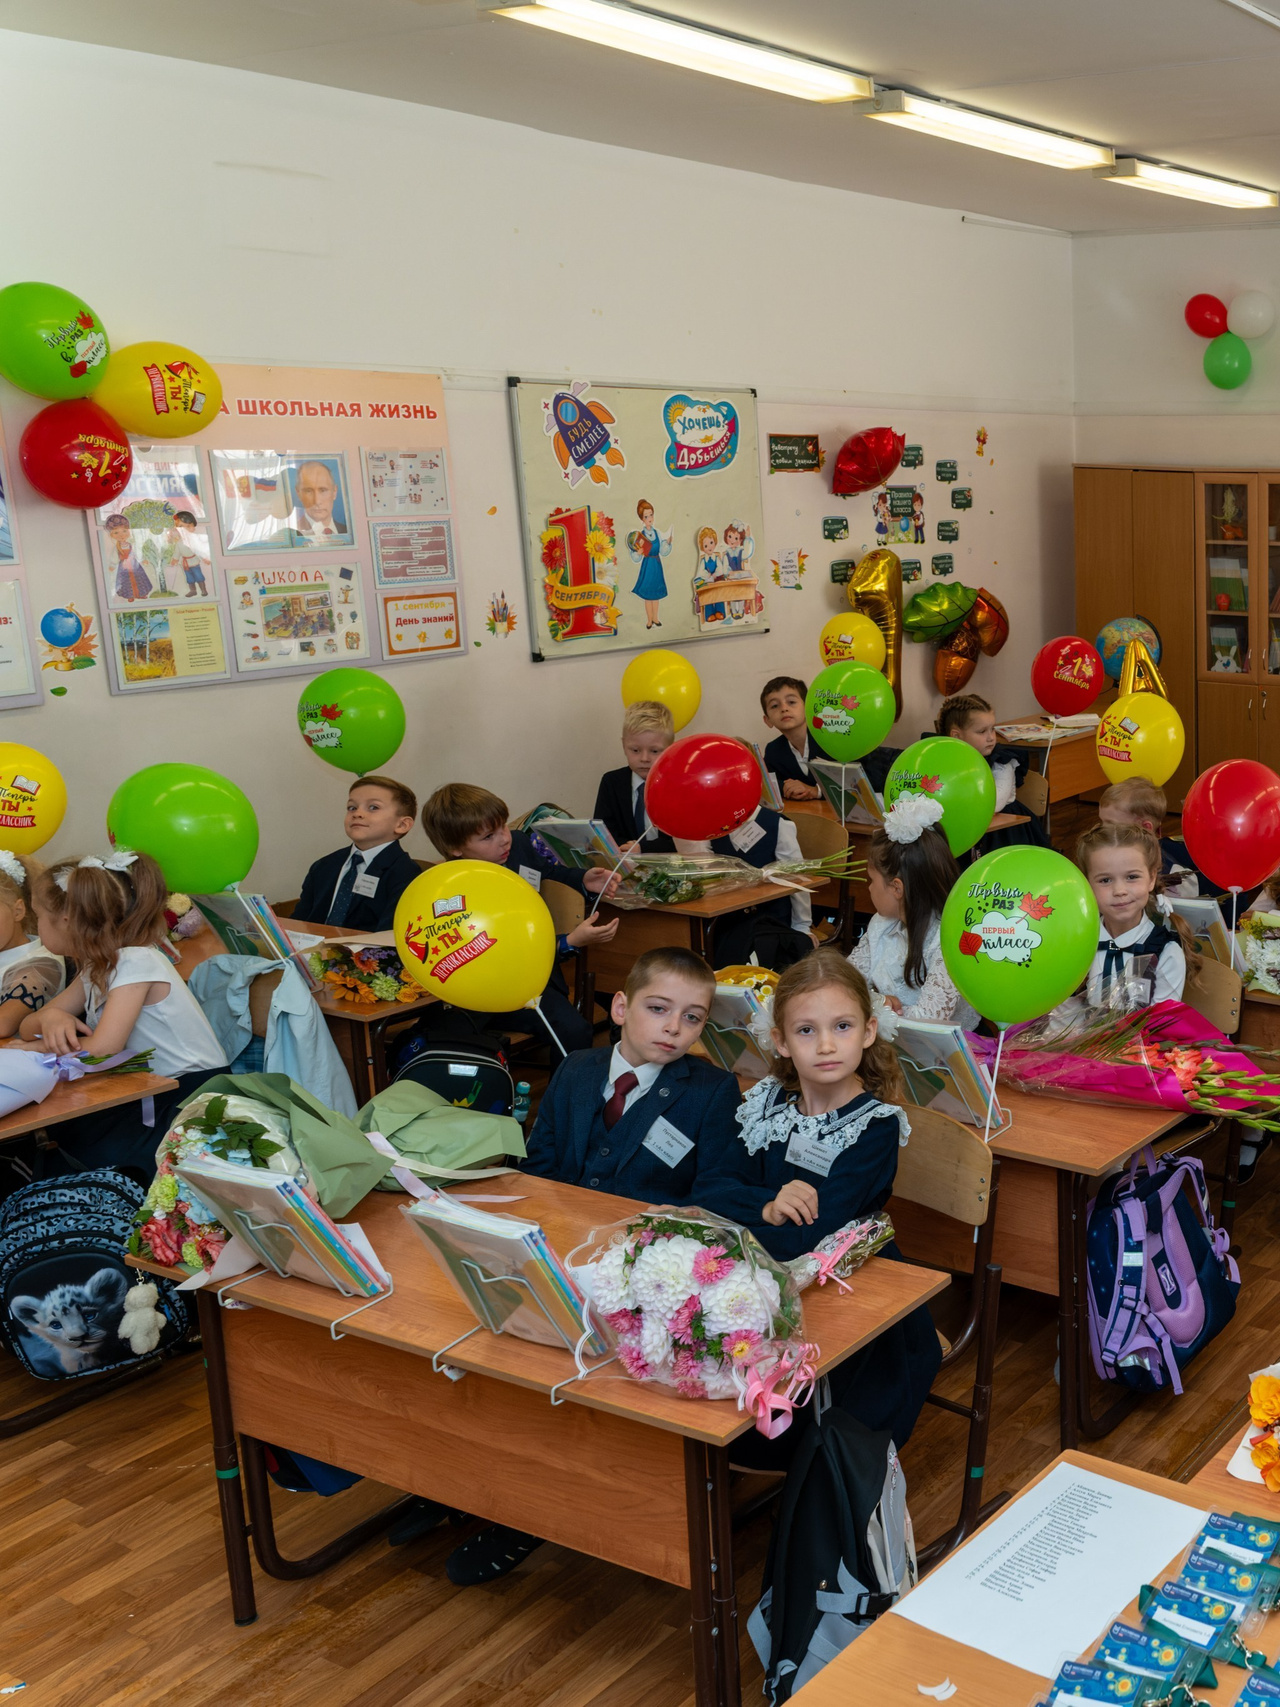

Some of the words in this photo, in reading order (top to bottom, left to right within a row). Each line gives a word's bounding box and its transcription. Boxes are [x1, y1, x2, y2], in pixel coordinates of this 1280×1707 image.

[44, 319, 78, 349] Первый
[70, 329, 84, 343] РАЗ
[80, 341, 96, 359] ПЕРВЫЙ
[86, 339, 105, 366] класс
[147, 367, 167, 413] ПЕРВОКЛАССНИК
[169, 385, 182, 401] ТЫ
[237, 399, 362, 418] ШКОЛЬНАЯ
[368, 403, 438, 419] ЖИЗНЬ
[567, 418, 592, 442] БУДЬ
[77, 433, 129, 458] Сентября
[571, 424, 606, 459] СМЕЛЕЕ
[677, 431, 731, 469] Добьёшься
[98, 451, 112, 477] 1
[261, 570, 324, 585] ШКОЛА
[547, 505, 617, 641] 1
[555, 590, 610, 603] СЕНТЯБРЯ!
[394, 603, 400, 611] 1
[403, 601, 446, 611] сентября
[395, 617, 420, 627] День
[422, 614, 455, 624] знаний
[1072, 657, 1083, 676] 1
[1053, 670, 1090, 691] Сентября
[814, 689, 843, 699] Первый
[306, 711, 318, 719] РАЗ
[823, 718, 850, 727] класс
[1107, 724, 1135, 741] Теперь
[1109, 736, 1122, 747] ТЫ
[891, 769, 923, 782] Первый
[902, 781, 917, 789] РАЗ
[1, 799, 20, 812] ТЫ
[967, 882, 1024, 899] Первый
[991, 898, 1015, 911] РАЗ
[424, 911, 473, 940] Теперь
[964, 907, 977, 927] в
[437, 927, 464, 949] ТЫ
[982, 926, 1015, 935] ПЕРВЫЙ
[982, 936, 1034, 950] класс
[434, 933, 492, 979] ПЕРВОКЛАССНИК
